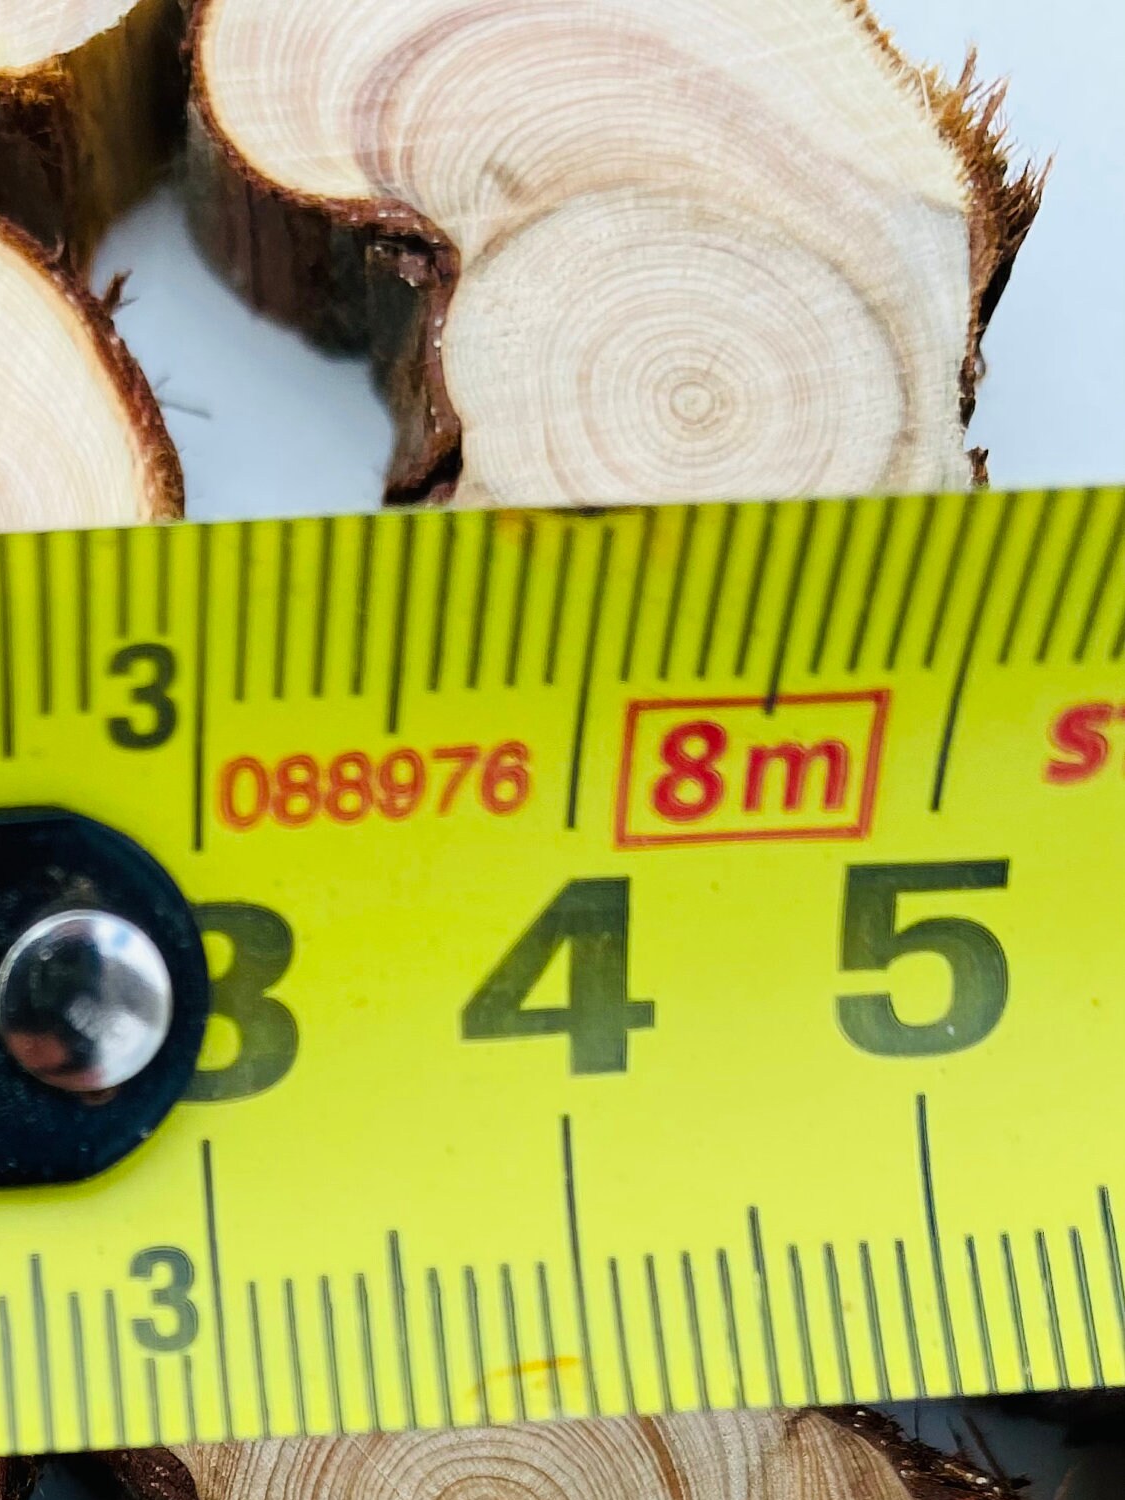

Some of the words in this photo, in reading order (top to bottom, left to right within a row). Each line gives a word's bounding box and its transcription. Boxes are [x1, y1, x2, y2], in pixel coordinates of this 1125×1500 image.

[104, 642, 179, 750] 3
[1041, 702, 1125, 787] S
[219, 739, 532, 830] 088976
[650, 720, 851, 825] 8m
[460, 876, 656, 1075] 4
[835, 858, 1012, 1058] 5
[129, 1245, 200, 1353] 3
